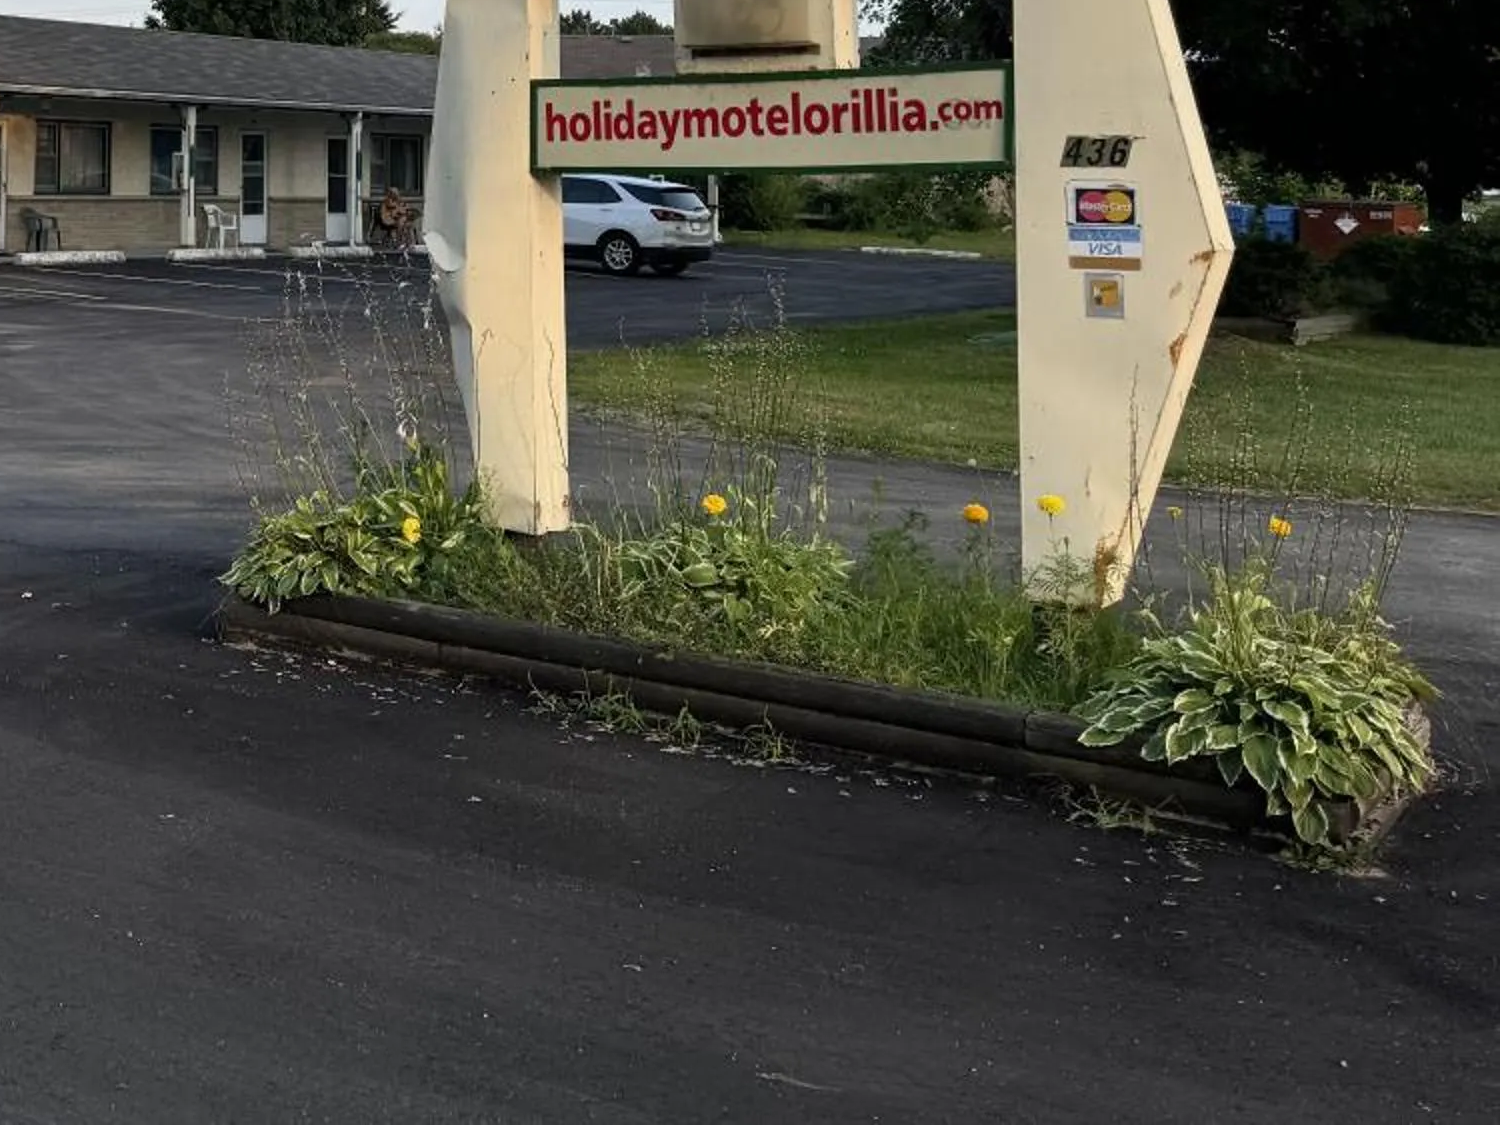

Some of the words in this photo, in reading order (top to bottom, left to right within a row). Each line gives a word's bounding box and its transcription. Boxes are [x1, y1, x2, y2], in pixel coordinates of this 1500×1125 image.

[544, 87, 1004, 152] holidaymotelorillia.com
[1065, 136, 1131, 167] 436
[1088, 241, 1124, 255] VISA
